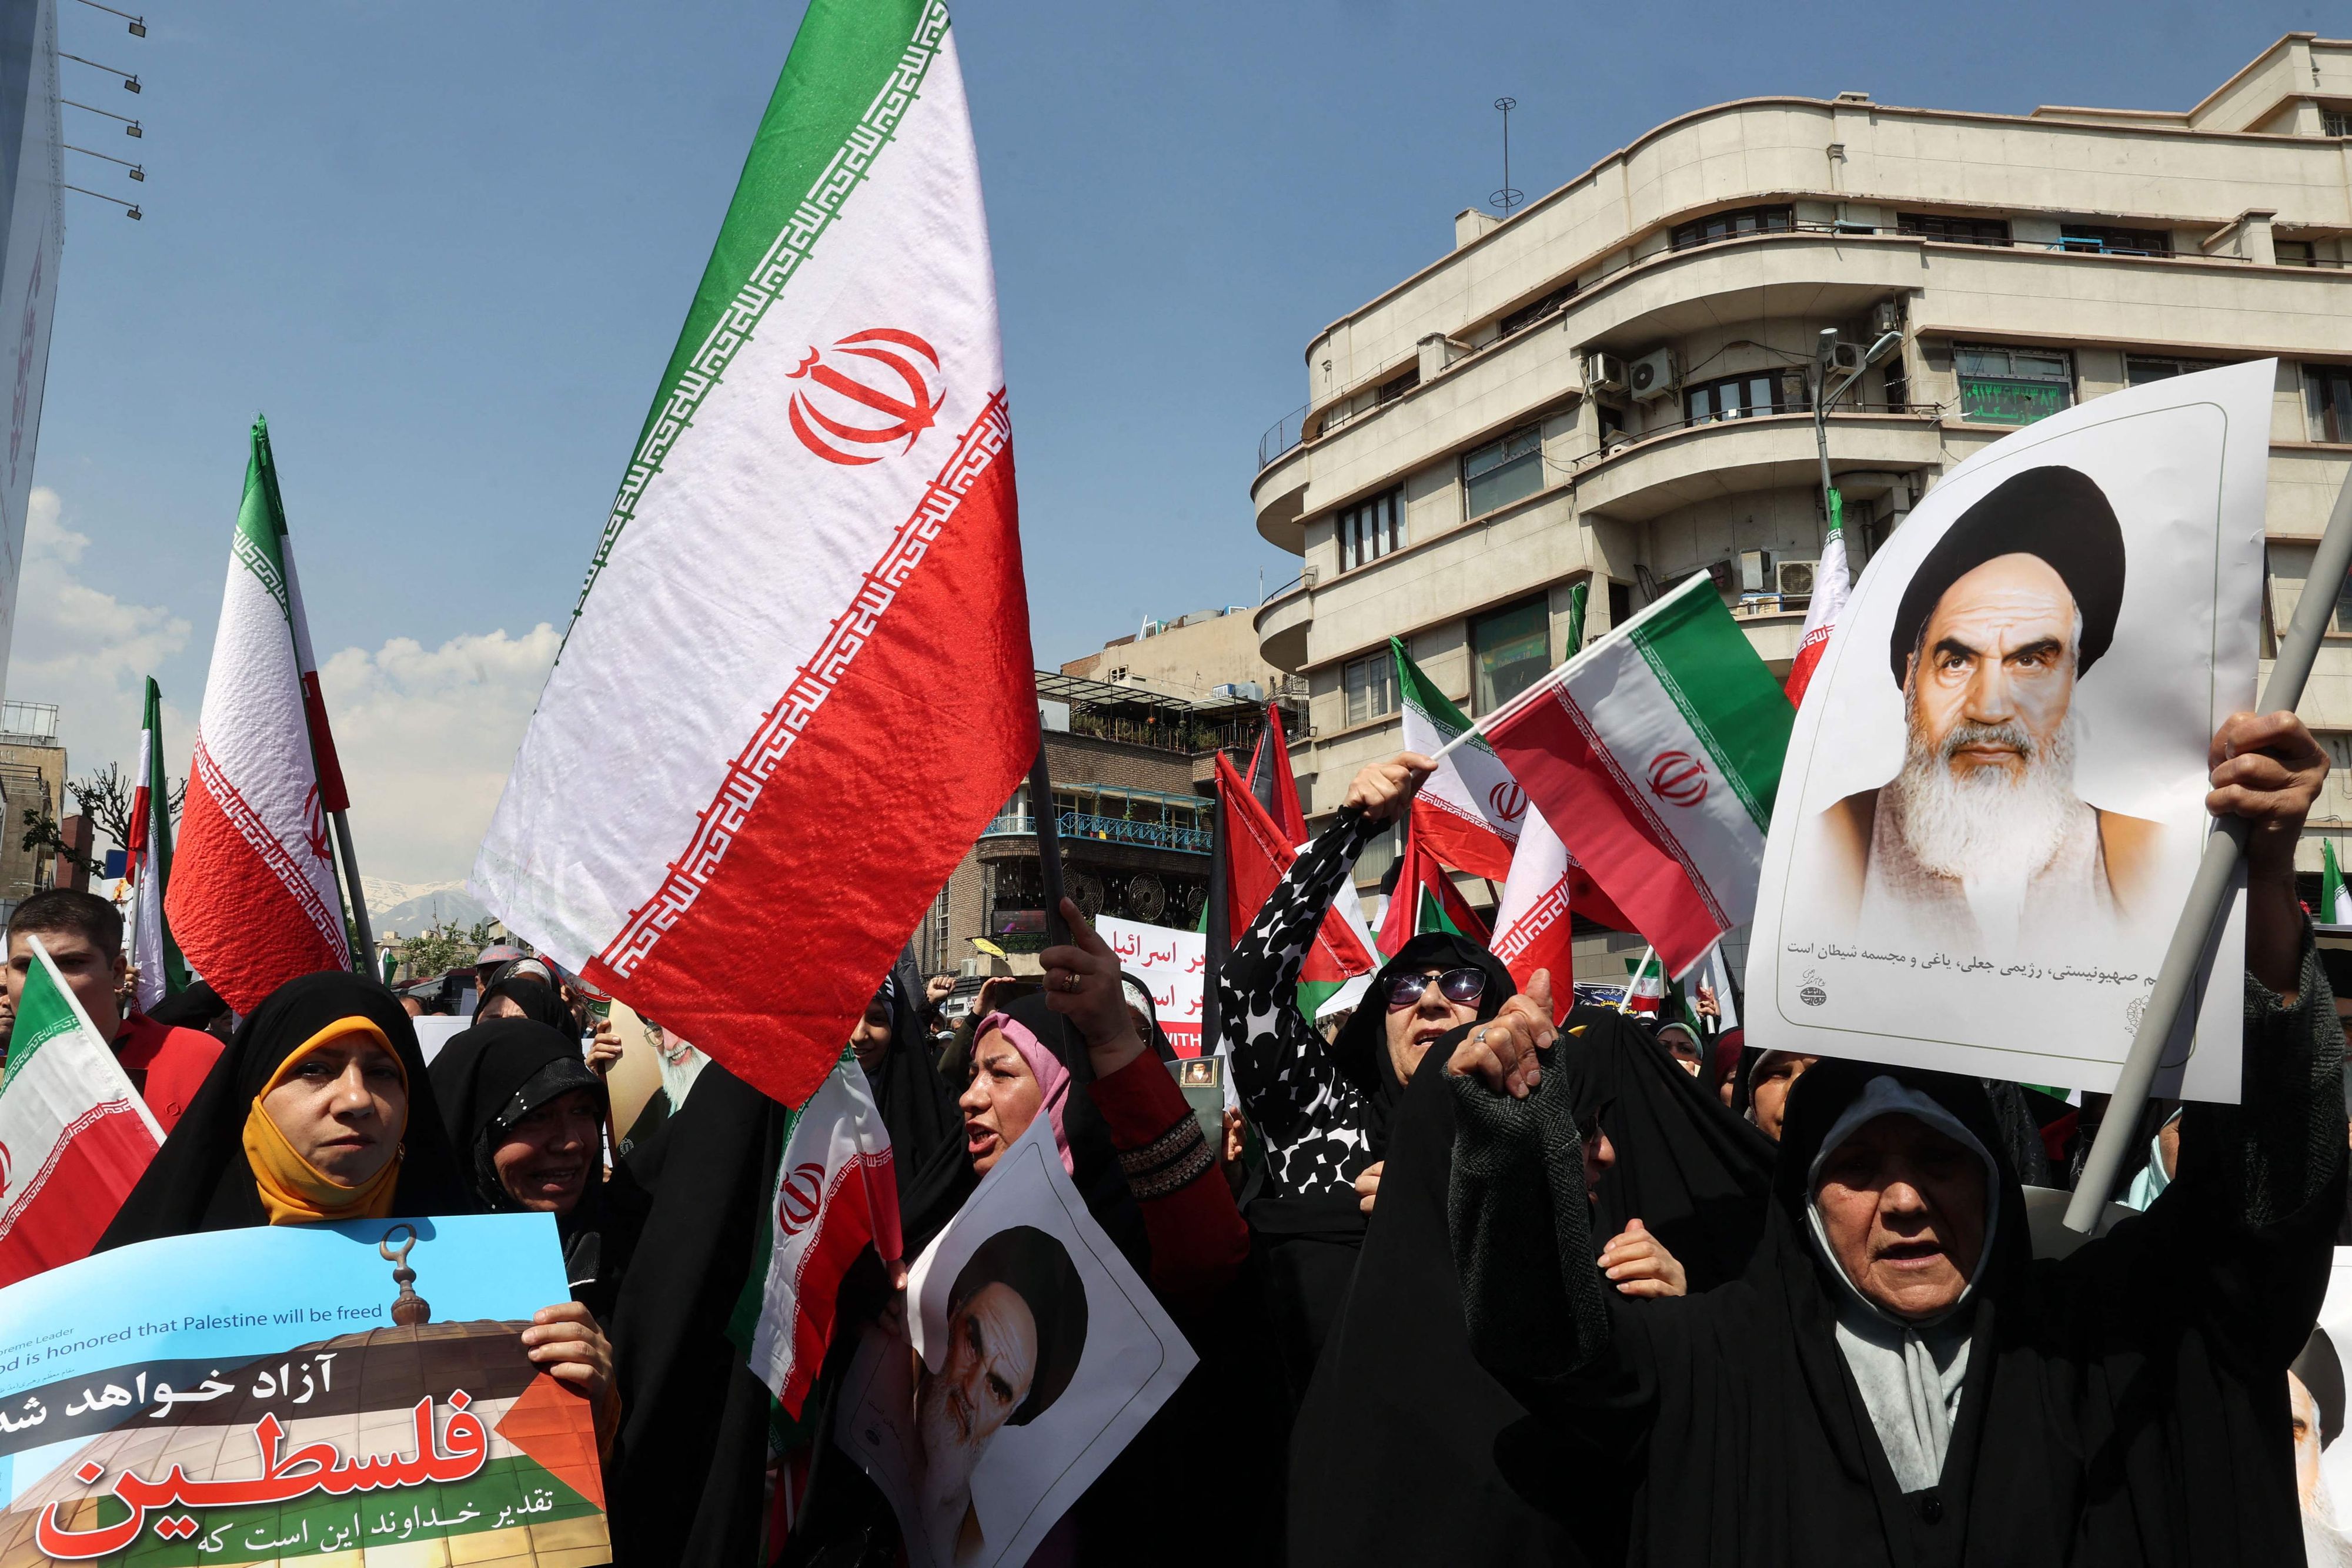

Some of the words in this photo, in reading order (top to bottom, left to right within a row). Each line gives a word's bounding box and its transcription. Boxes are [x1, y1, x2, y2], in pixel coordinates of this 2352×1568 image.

[1788, 942, 1814, 954] است
[1818, 944, 1857, 959] شیطان
[1862, 950, 1906, 965] مجسمه
[1910, 956, 1916, 968] و
[1922, 952, 1950, 969] یاغی
[2000, 962, 2042, 978] رژیمی
[26, 1353, 39, 1366] is
[48, 1326, 131, 1359] honored
[138, 1320, 177, 1336] that
[184, 1313, 267, 1330] Palestine
[273, 1309, 303, 1324] will
[310, 1308, 332, 1322] be
[338, 1303, 382, 1320] freed
[36, 1327, 74, 1343] Leader
[252, 1353, 338, 1403] آزاد
[65, 1369, 235, 1418] خواهد
[35, 1389, 489, 1560] فلسطین
[370, 1501, 480, 1539] خداوند
[491, 1489, 554, 1529] تقدیر
[198, 1523, 233, 1553] که
[245, 1519, 308, 1550] است
[320, 1513, 360, 1551] این
